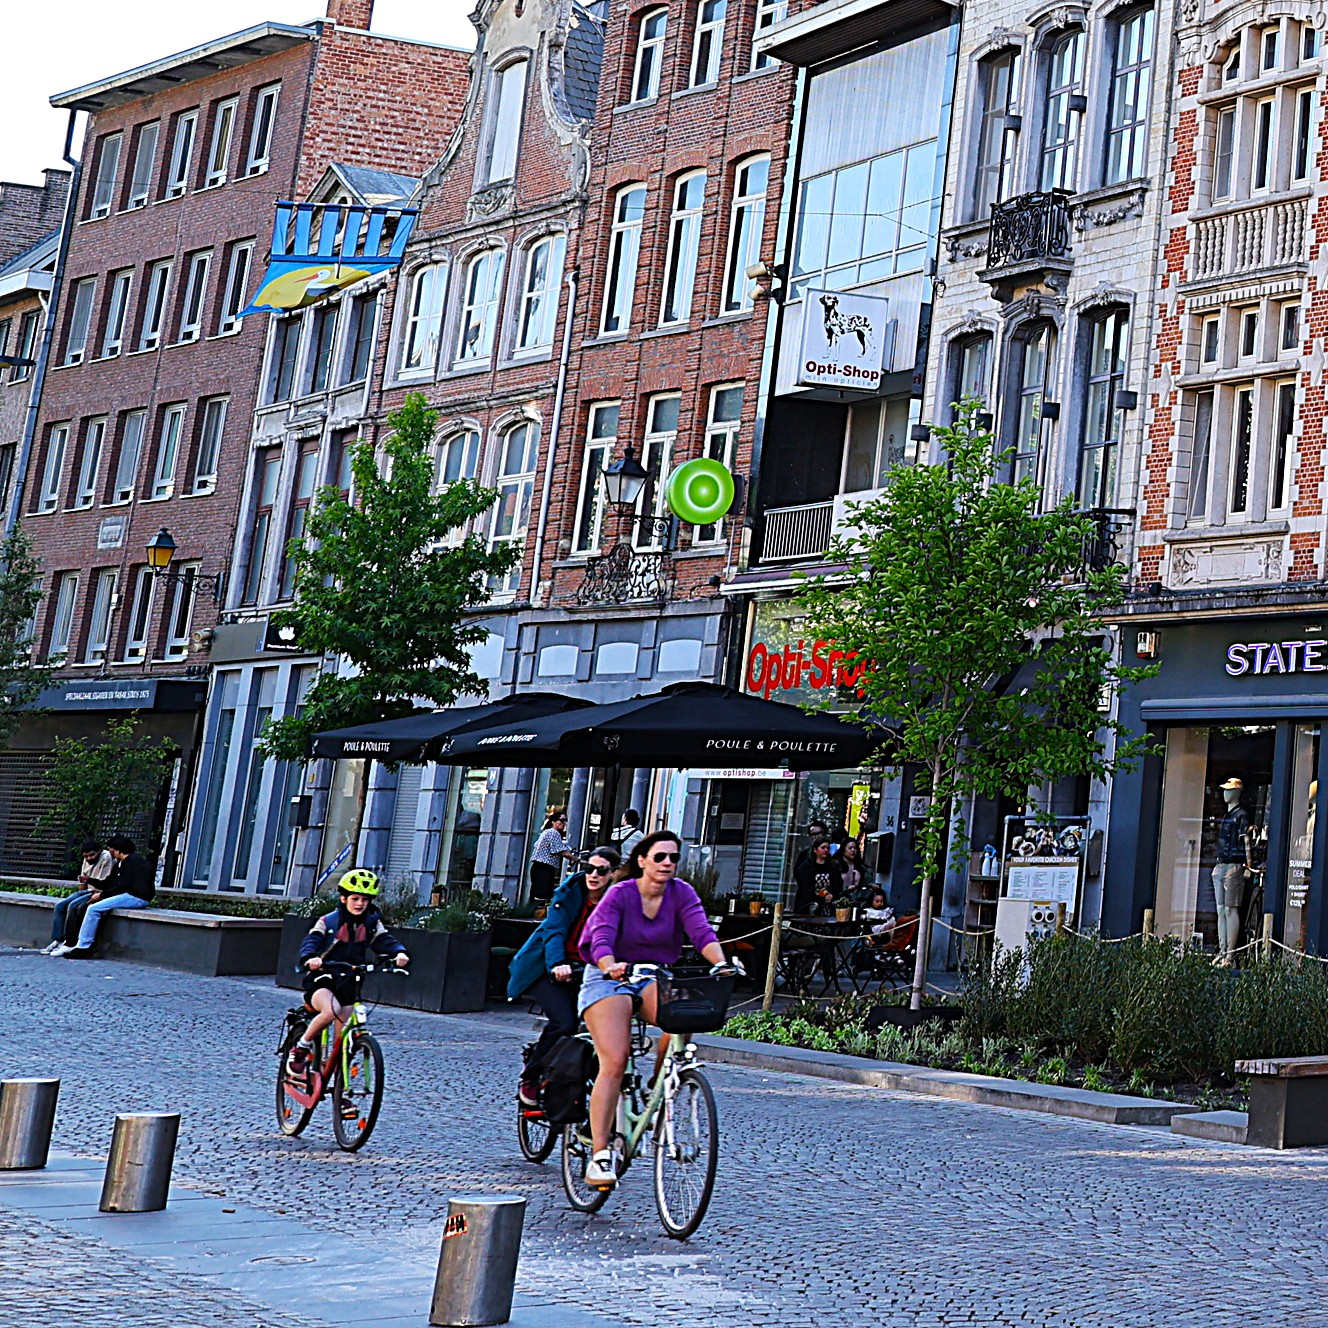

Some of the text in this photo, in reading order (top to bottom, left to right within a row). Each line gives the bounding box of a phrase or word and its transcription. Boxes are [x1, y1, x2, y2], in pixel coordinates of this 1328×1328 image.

[805, 360, 880, 382] Opti-Shop
[1225, 640, 1328, 676] STATE
[343, 741, 360, 752] POULE
[364, 742, 391, 753] POULETTE
[705, 739, 838, 753] POULE & POULETTE
